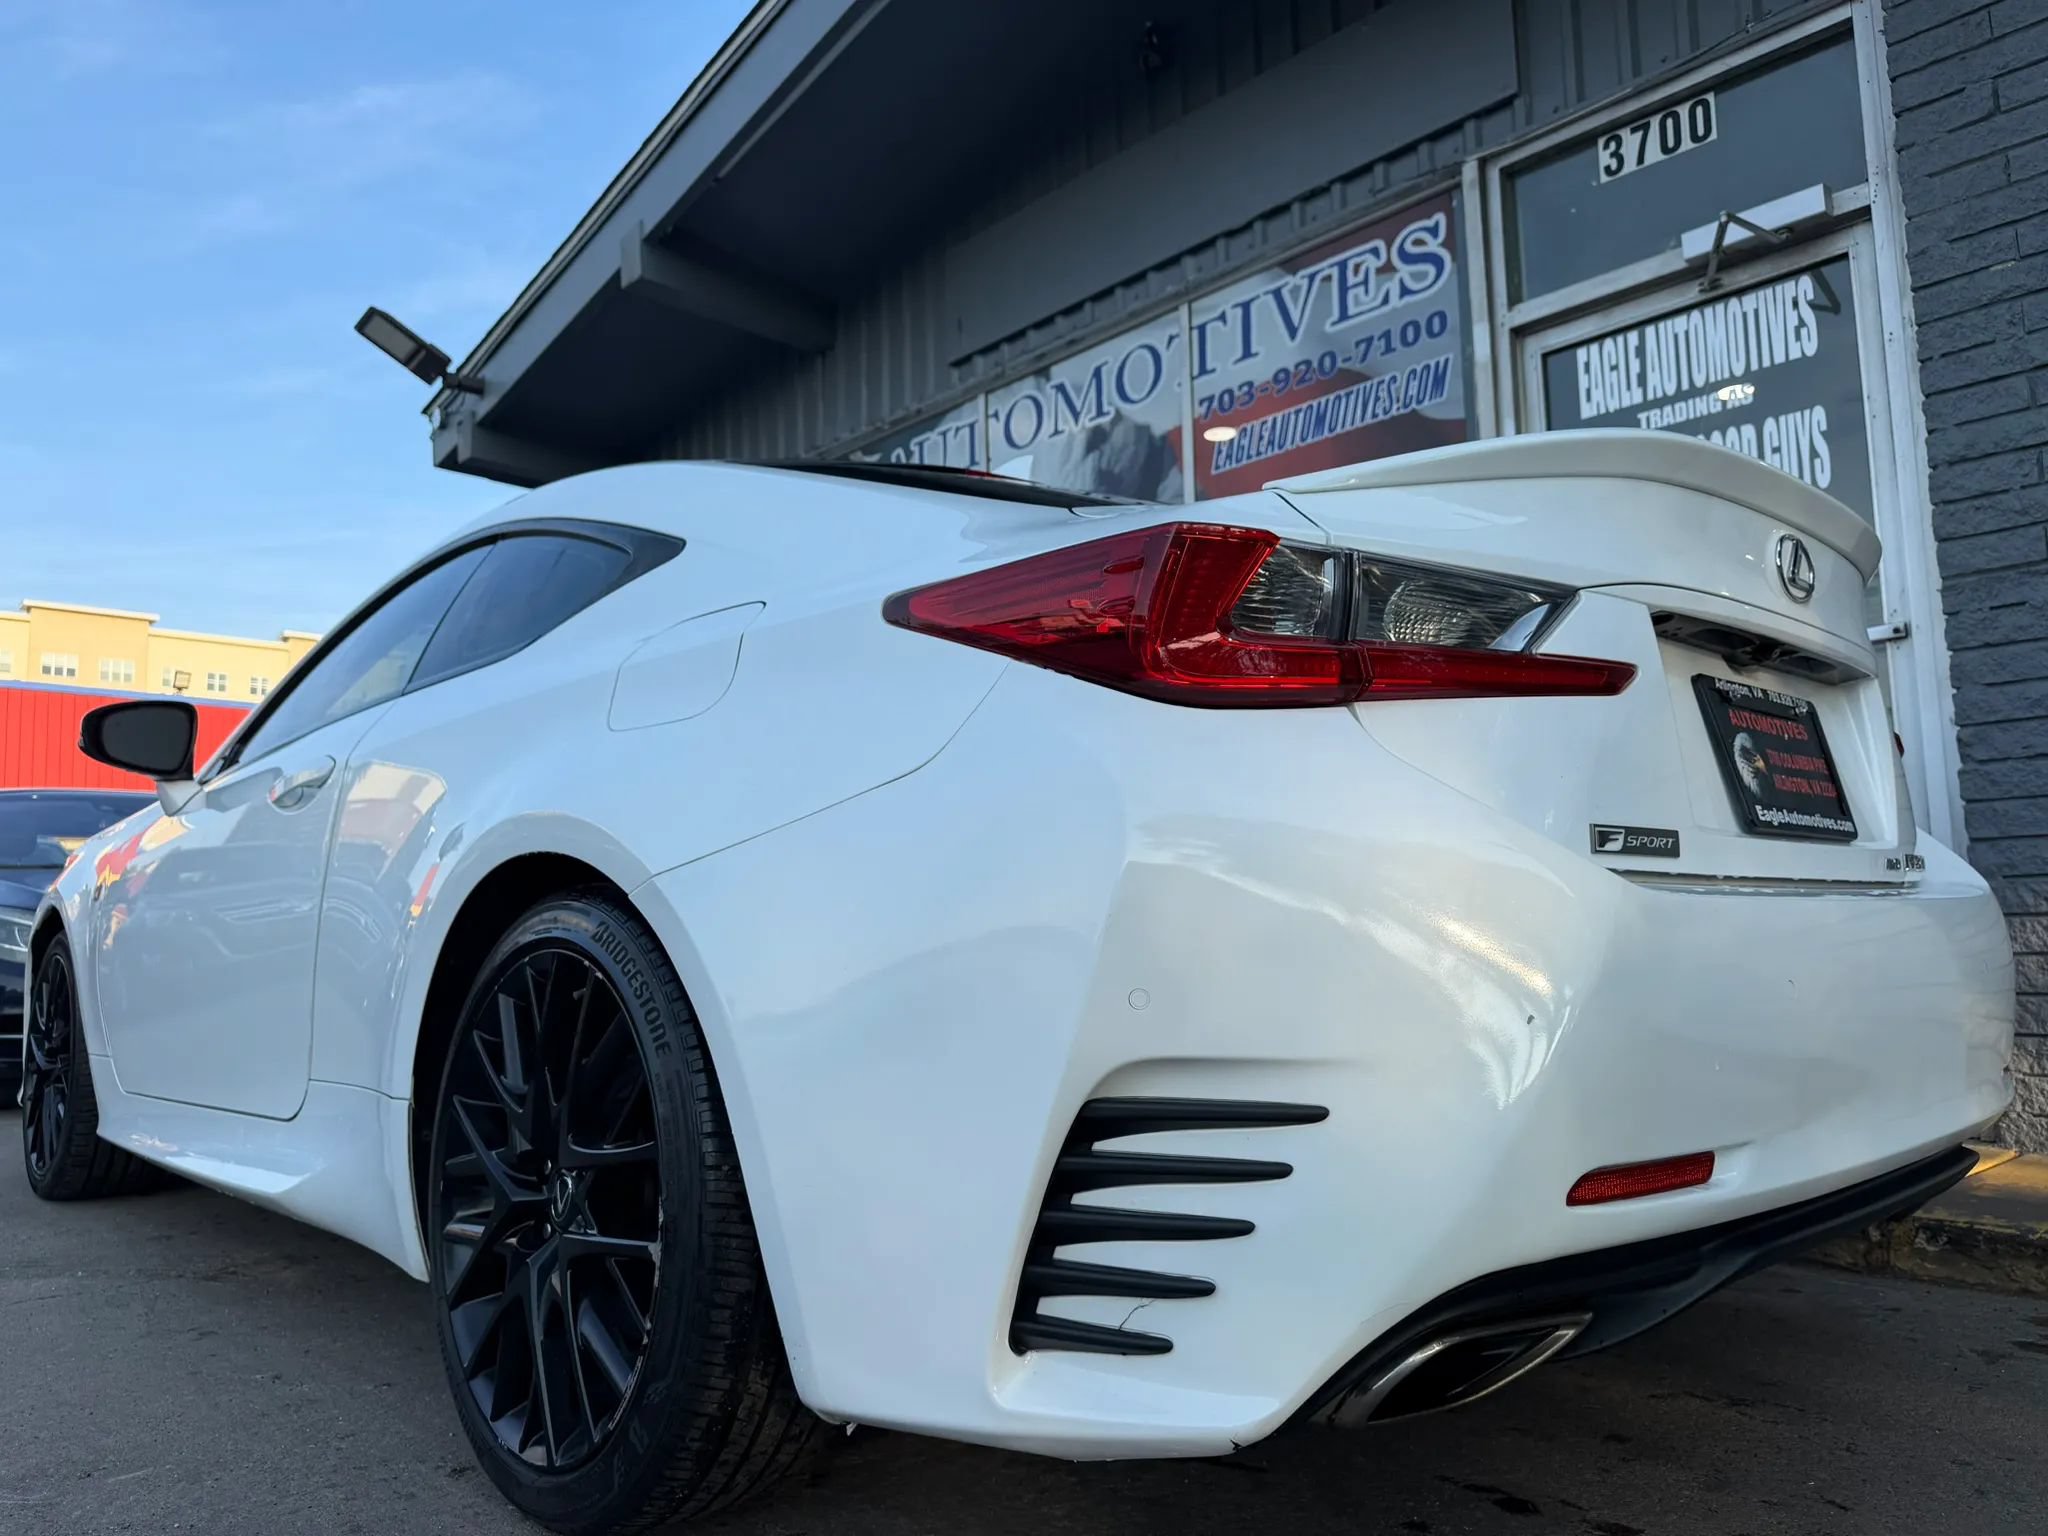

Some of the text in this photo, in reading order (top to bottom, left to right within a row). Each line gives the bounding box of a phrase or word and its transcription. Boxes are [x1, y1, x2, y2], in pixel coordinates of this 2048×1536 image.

[1602, 97, 1714, 179] 3700
[1199, 309, 1448, 422] 703-920-7100
[1576, 275, 1819, 420] EAGLE AUTOMOTIVES
[1212, 355, 1452, 475] EAGLEAUTOMOTIVES.COM
[1637, 383, 1755, 430] TRADING AS
[1728, 709, 1808, 740] AUTOMOTIVES
[1626, 835, 1676, 849] SPORT
[1755, 804, 1855, 833] EagleAutomotives.com
[590, 921, 673, 1059] BRIDGESTONE
